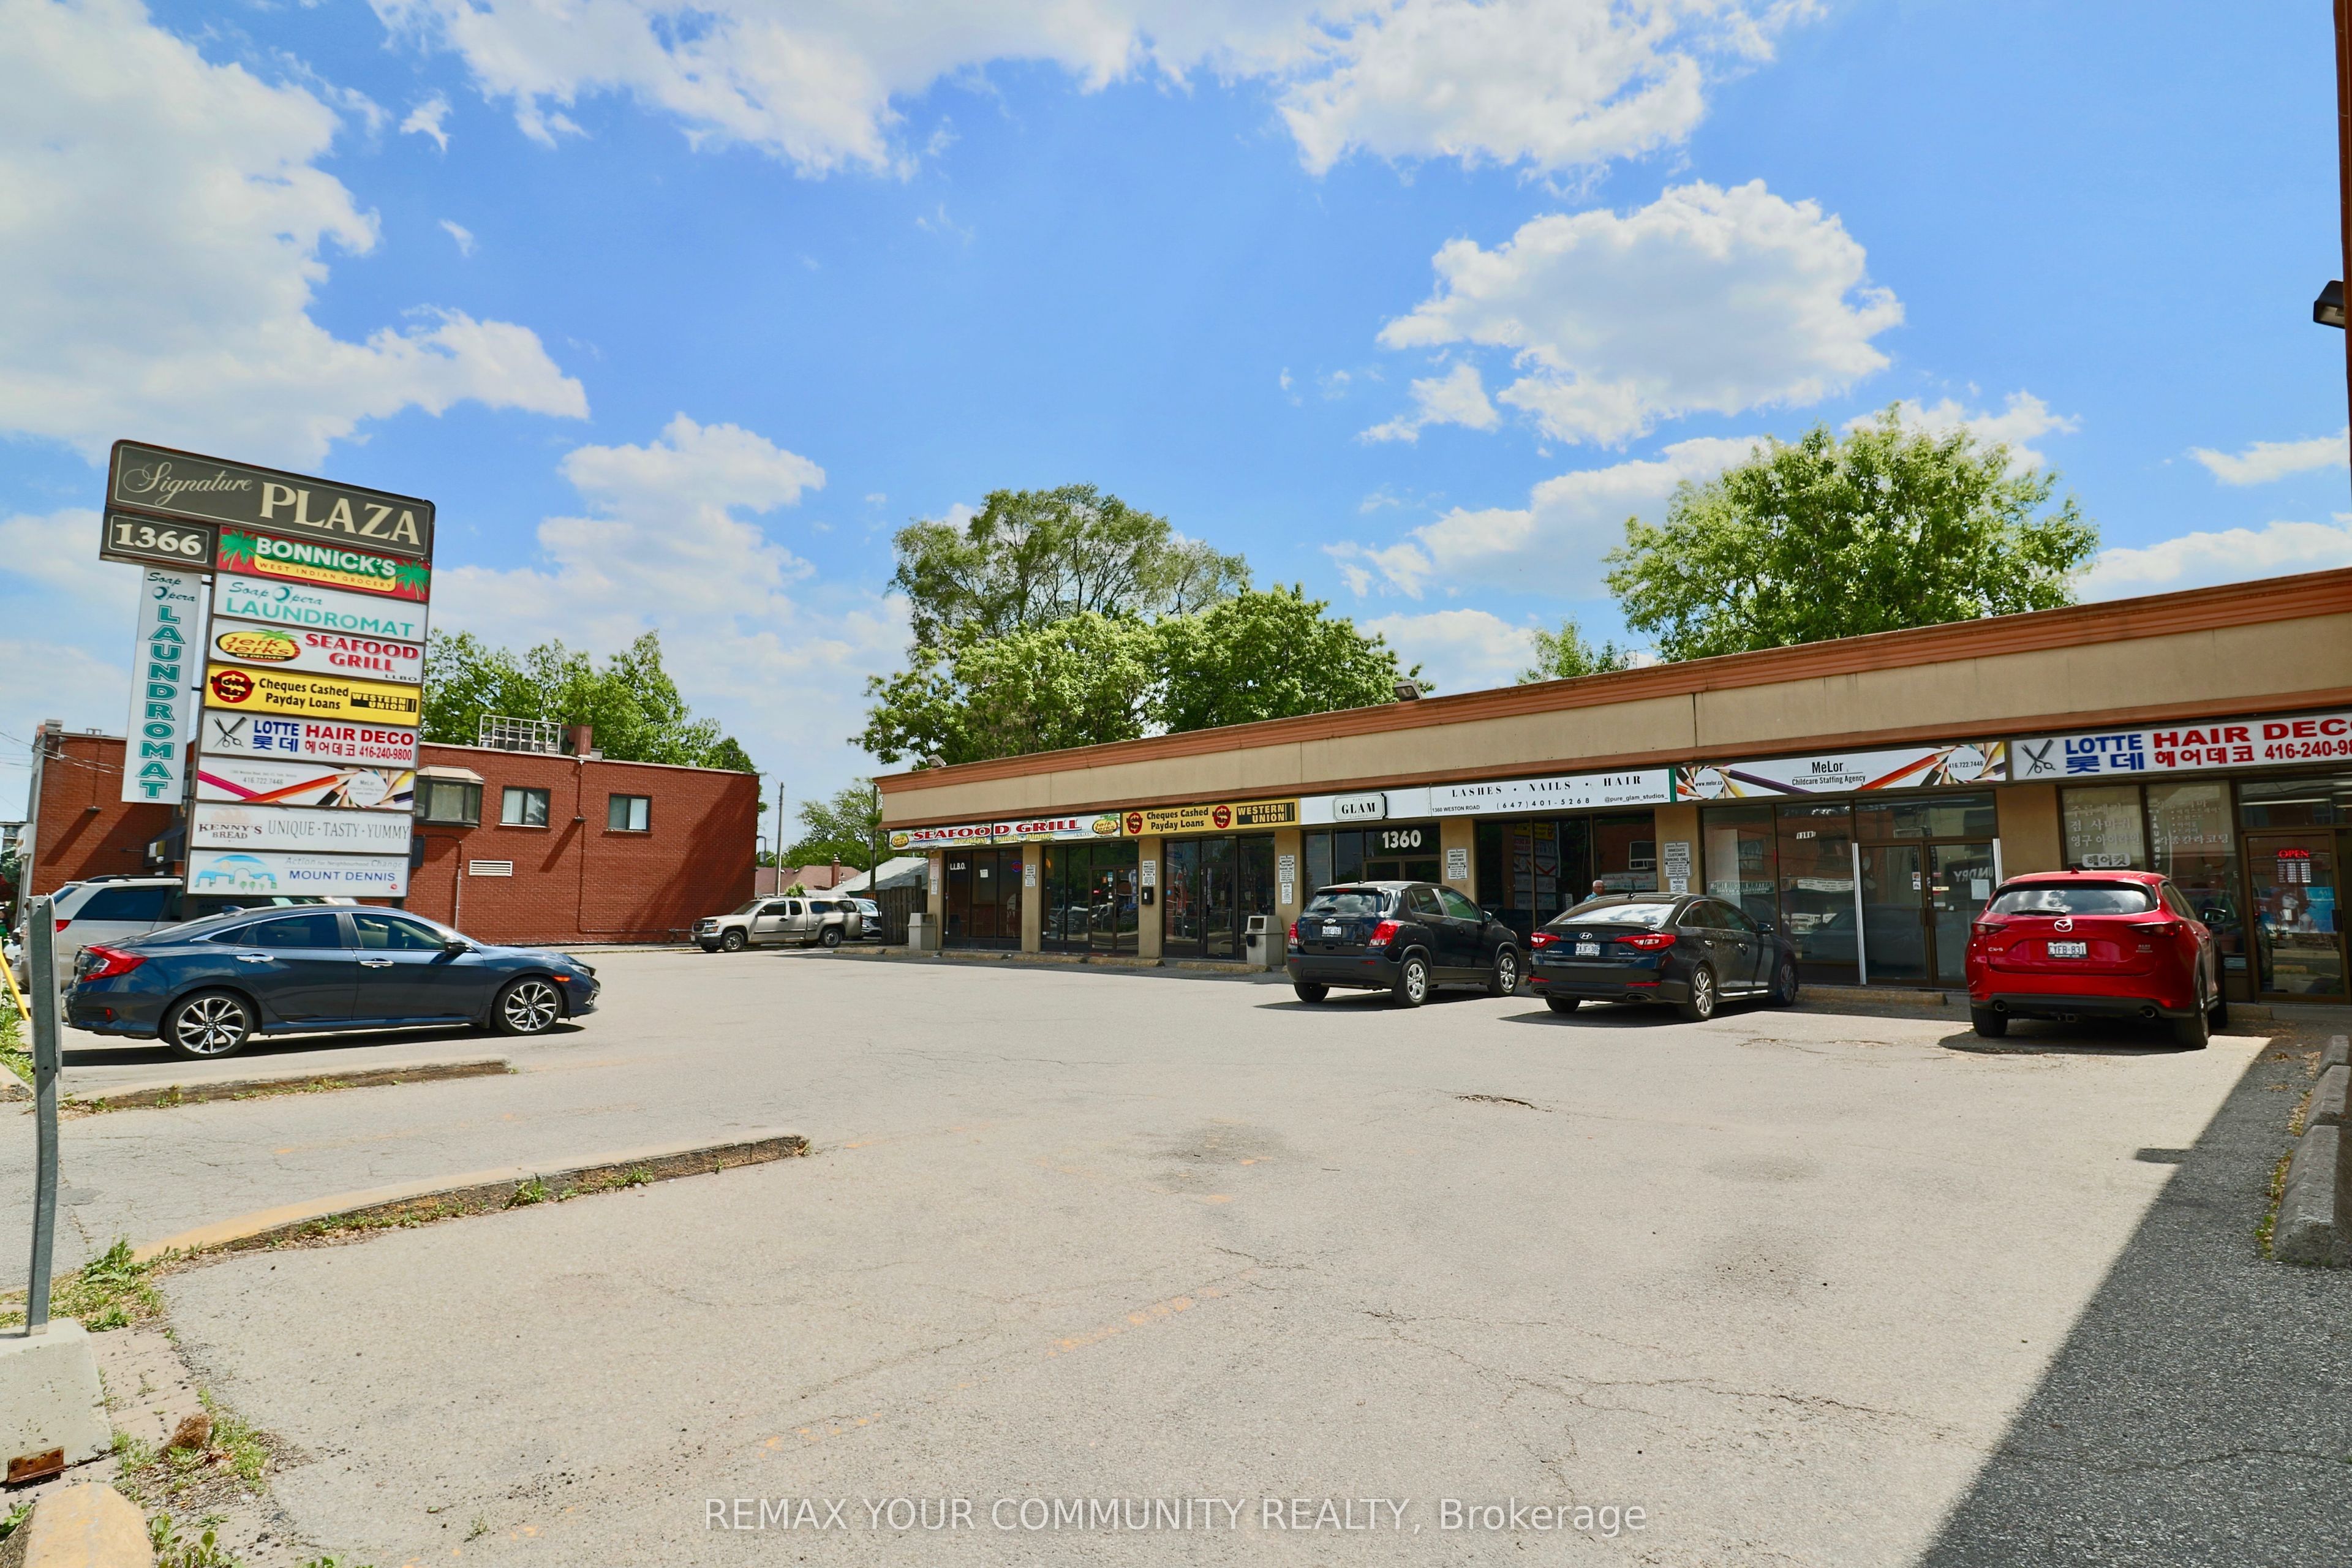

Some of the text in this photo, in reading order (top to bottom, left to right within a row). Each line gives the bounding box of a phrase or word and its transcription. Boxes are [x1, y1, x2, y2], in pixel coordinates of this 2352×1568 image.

[123, 462, 421, 546] Signature PLAZA
[116, 523, 202, 556] 1366
[255, 537, 397, 578] BONNICK'S
[147, 572, 181, 586] Soap
[260, 562, 393, 589] WEST INDIAN GROCERY
[229, 582, 268, 598] Soap
[226, 598, 415, 637] LAUNDROMAT
[305, 633, 419, 660] SEAFOOD
[329, 652, 396, 673] GRILL
[385, 674, 418, 682] LLBO
[259, 678, 349, 697] Cheques Cashed
[135, 605, 186, 799] LAUNDROMAT
[266, 693, 341, 710] Payday Loans
[352, 693, 407, 704] WESTERN
[369, 701, 406, 711] UNION
[254, 720, 414, 745] LOTTE HAIR DECO
[2065, 718, 2352, 755] LOTTE HAIR DEC
[360, 745, 412, 761] 416-240-9800
[1812, 761, 1843, 774] MeLor
[1452, 775, 1641, 797] LASHES NAILS HAIR
[1820, 777, 1842, 785] Staffing
[1844, 774, 1866, 783] Agency
[1147, 807, 1208, 821] Cheques Cashed
[1238, 804, 1284, 815] WESTERN
[1341, 802, 1375, 814] GLAM
[1252, 813, 1284, 823] UNION
[198, 823, 263, 835] KENNY'S
[268, 820, 412, 840] UNIQUE TASTY YUMMY
[913, 820, 1082, 841] SEAFOOD GRILL
[1151, 821, 1178, 832] Payday
[1382, 830, 1421, 848] 1360
[2278, 850, 2309, 858] OPEN
[371, 859, 402, 868] Change
[289, 870, 396, 881] MOUNT DENNIS
